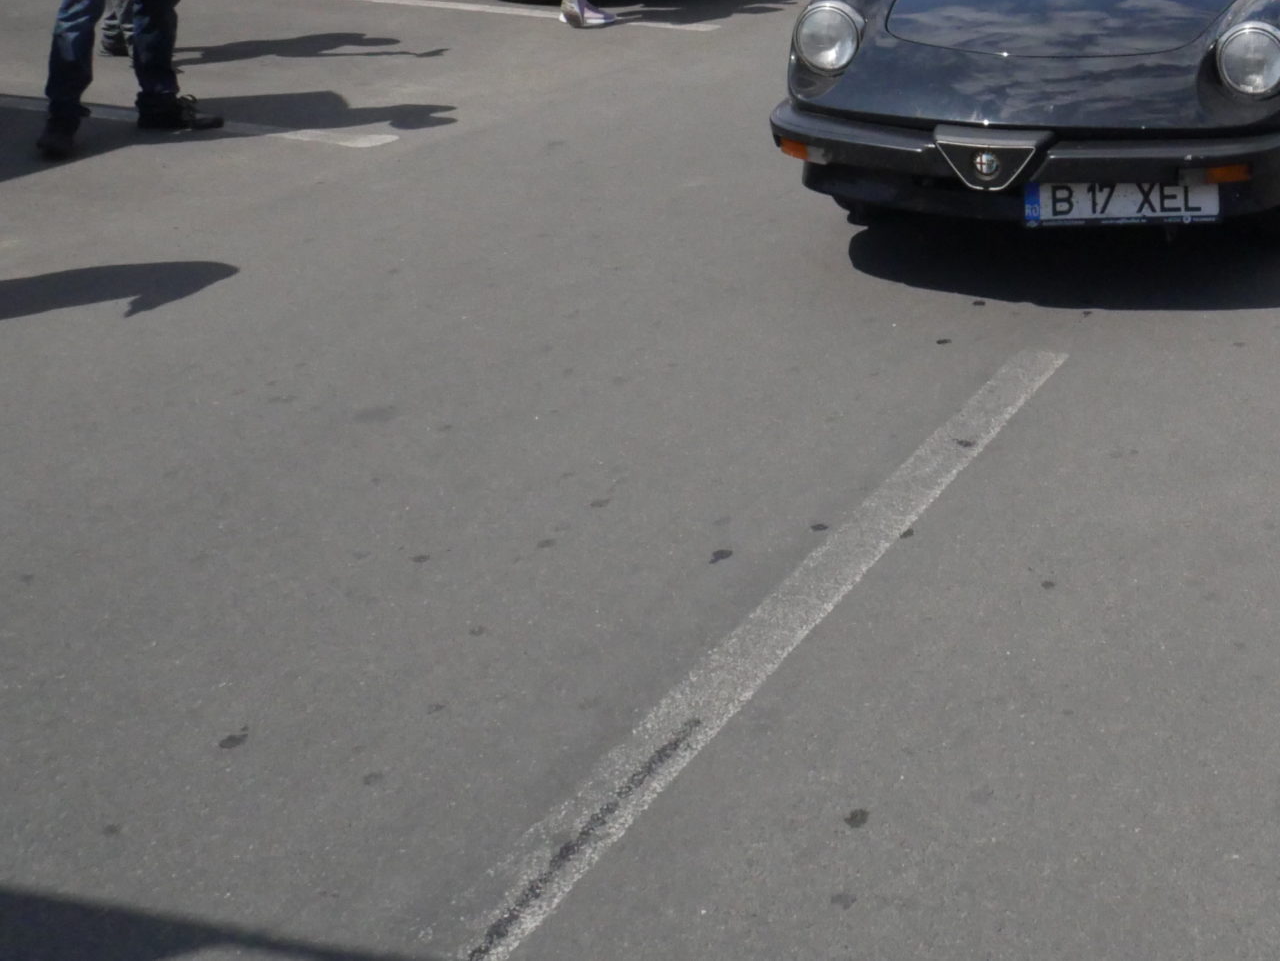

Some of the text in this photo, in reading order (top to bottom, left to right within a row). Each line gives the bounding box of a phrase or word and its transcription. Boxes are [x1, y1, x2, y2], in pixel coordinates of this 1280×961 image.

[1052, 183, 1202, 216] B 17 XEL
